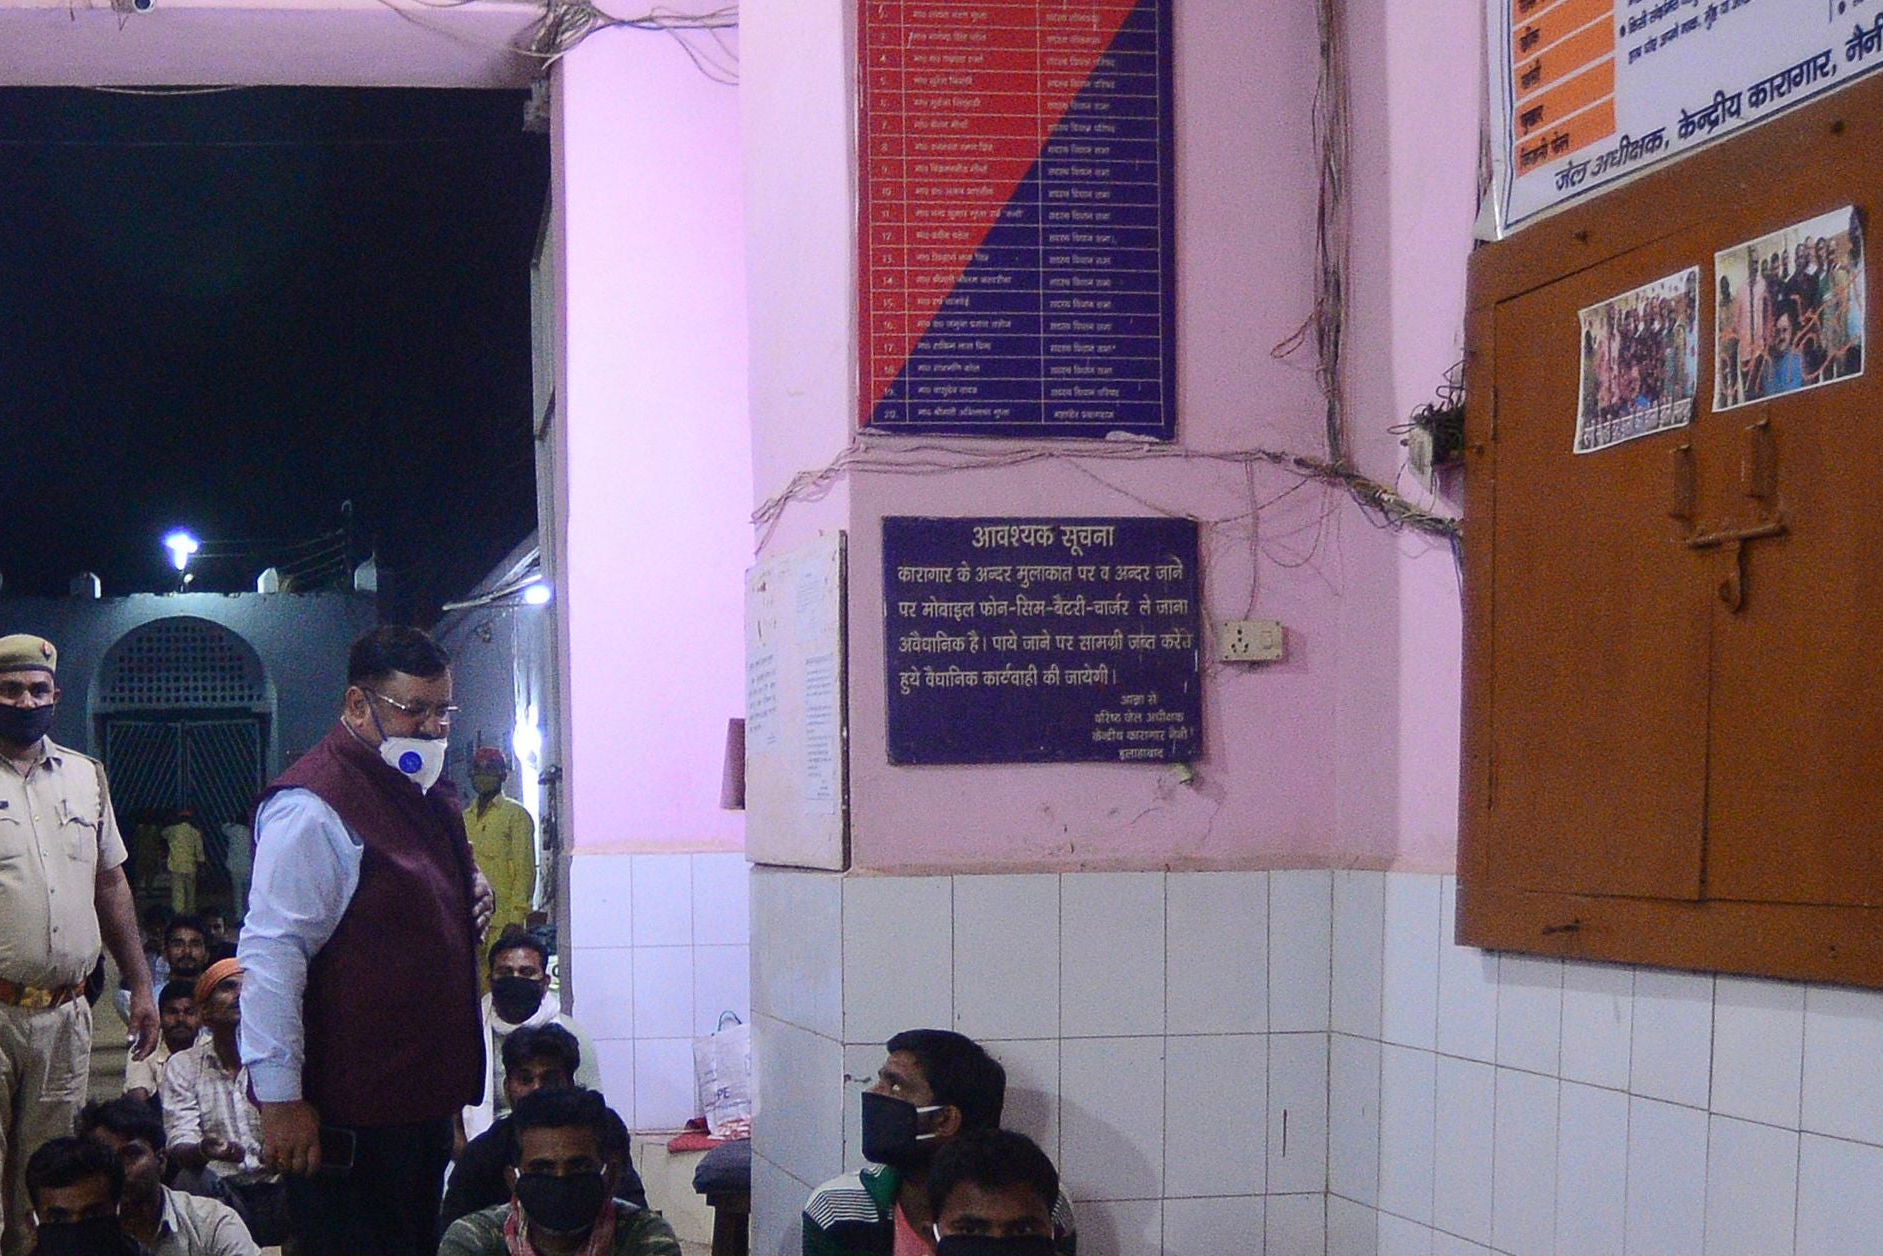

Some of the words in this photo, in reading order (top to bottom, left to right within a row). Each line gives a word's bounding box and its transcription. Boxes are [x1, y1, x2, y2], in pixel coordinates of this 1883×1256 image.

[1555, 160, 1590, 191] जेल
[1591, 127, 1669, 176] अधीक्षक,
[1678, 90, 1743, 140] केन्द्रीय
[1748, 48, 1837, 109] कारागार,
[972, 525, 1054, 547] आवश्यक
[1061, 525, 1115, 556] सूचना
[898, 564, 951, 584] कारागार
[957, 561, 970, 582] के
[977, 567, 1011, 583] अन्दर
[1017, 566, 1072, 588] मुलाकात
[1078, 566, 1094, 583] पर
[1100, 566, 1109, 583] व
[1115, 567, 1150, 582] अन्दर
[1156, 558, 1184, 580] जाने
[899, 601, 916, 618] पर
[1140, 597, 1151, 616] ले
[1156, 600, 1188, 615] जाना
[899, 632, 965, 653] अवैधानिक
[993, 631, 1018, 651] पाये
[1023, 630, 1050, 652] जाने
[1056, 634, 1074, 651] पर
[1080, 632, 1123, 652] सामग्री
[1129, 636, 1155, 651] जब्त
[900, 666, 920, 694] हुये
[926, 665, 978, 687] वैधानिक
[1044, 665, 1060, 686] की
